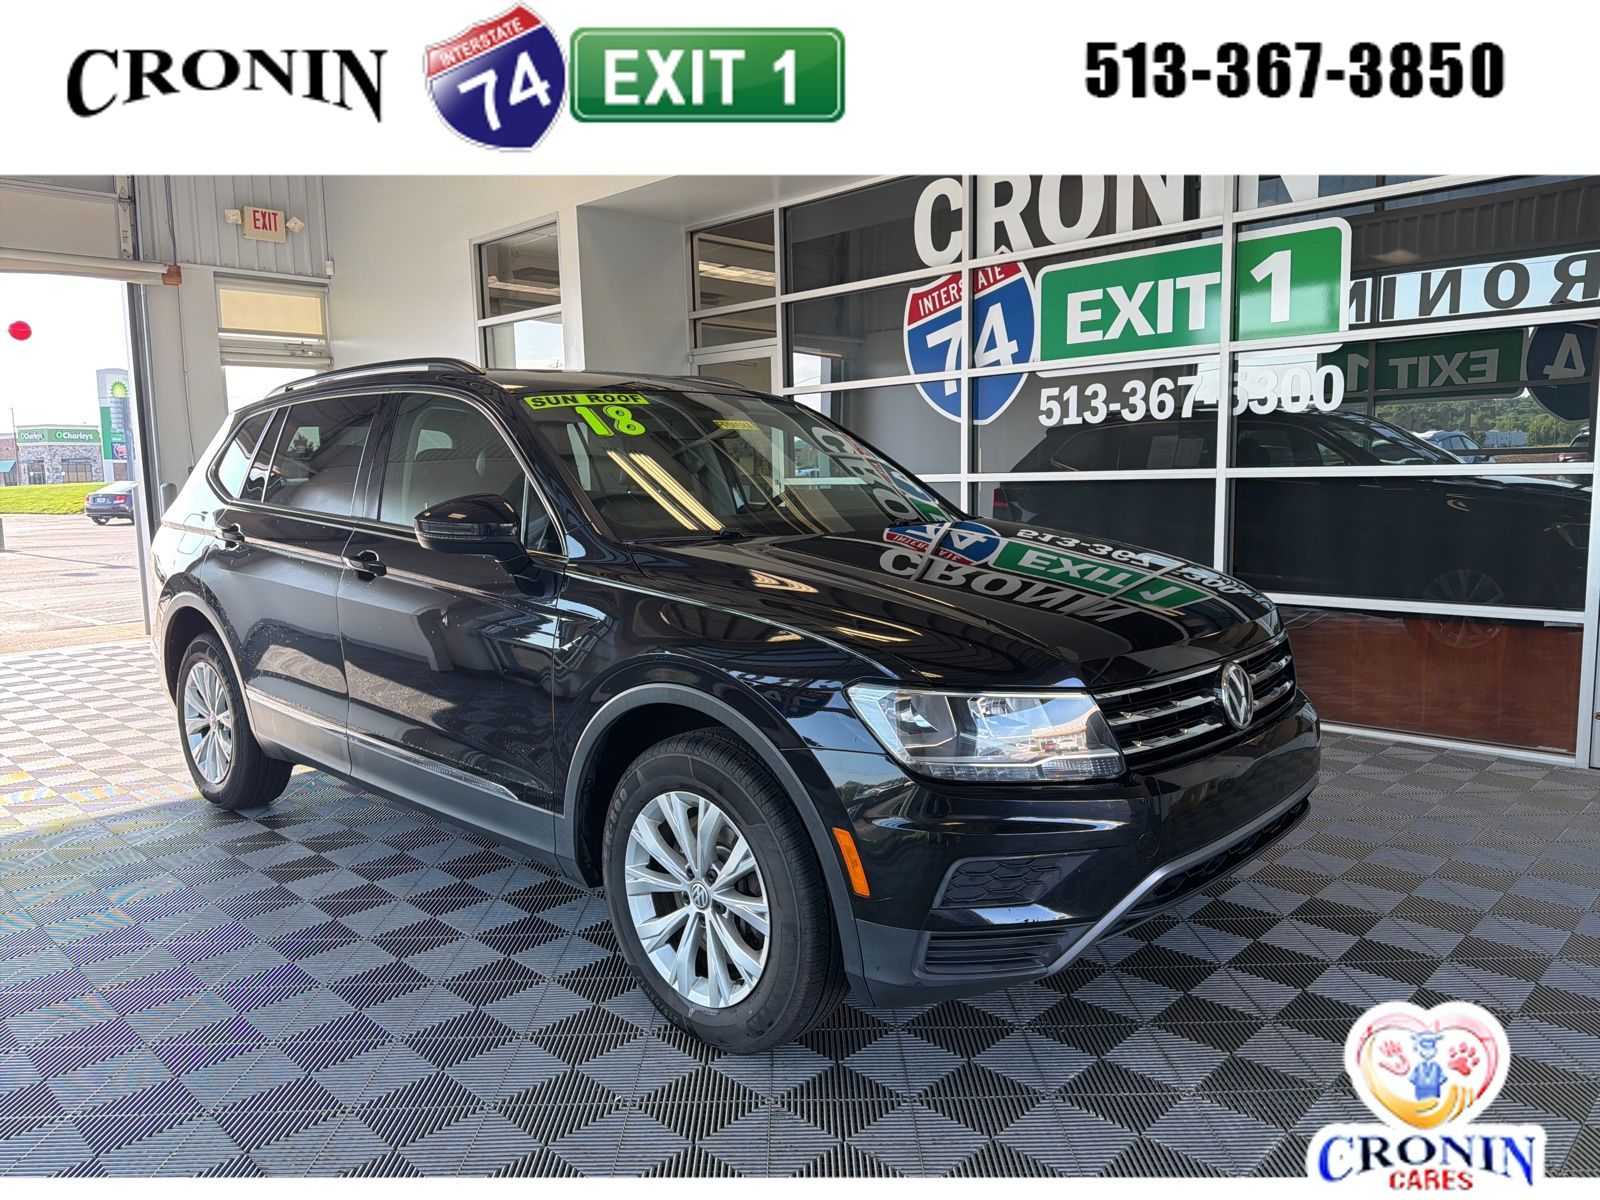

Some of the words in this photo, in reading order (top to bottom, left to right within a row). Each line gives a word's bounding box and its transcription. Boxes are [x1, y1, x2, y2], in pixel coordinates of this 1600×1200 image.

[252, 209, 279, 232] EXIT
[918, 265, 1005, 317] INTERATE
[1066, 272, 1222, 345] EXIT
[1250, 250, 1292, 323] 1
[926, 302, 1019, 396] 74
[531, 394, 578, 407] SUN
[587, 393, 643, 404] ROOF
[575, 405, 647, 436] 18
